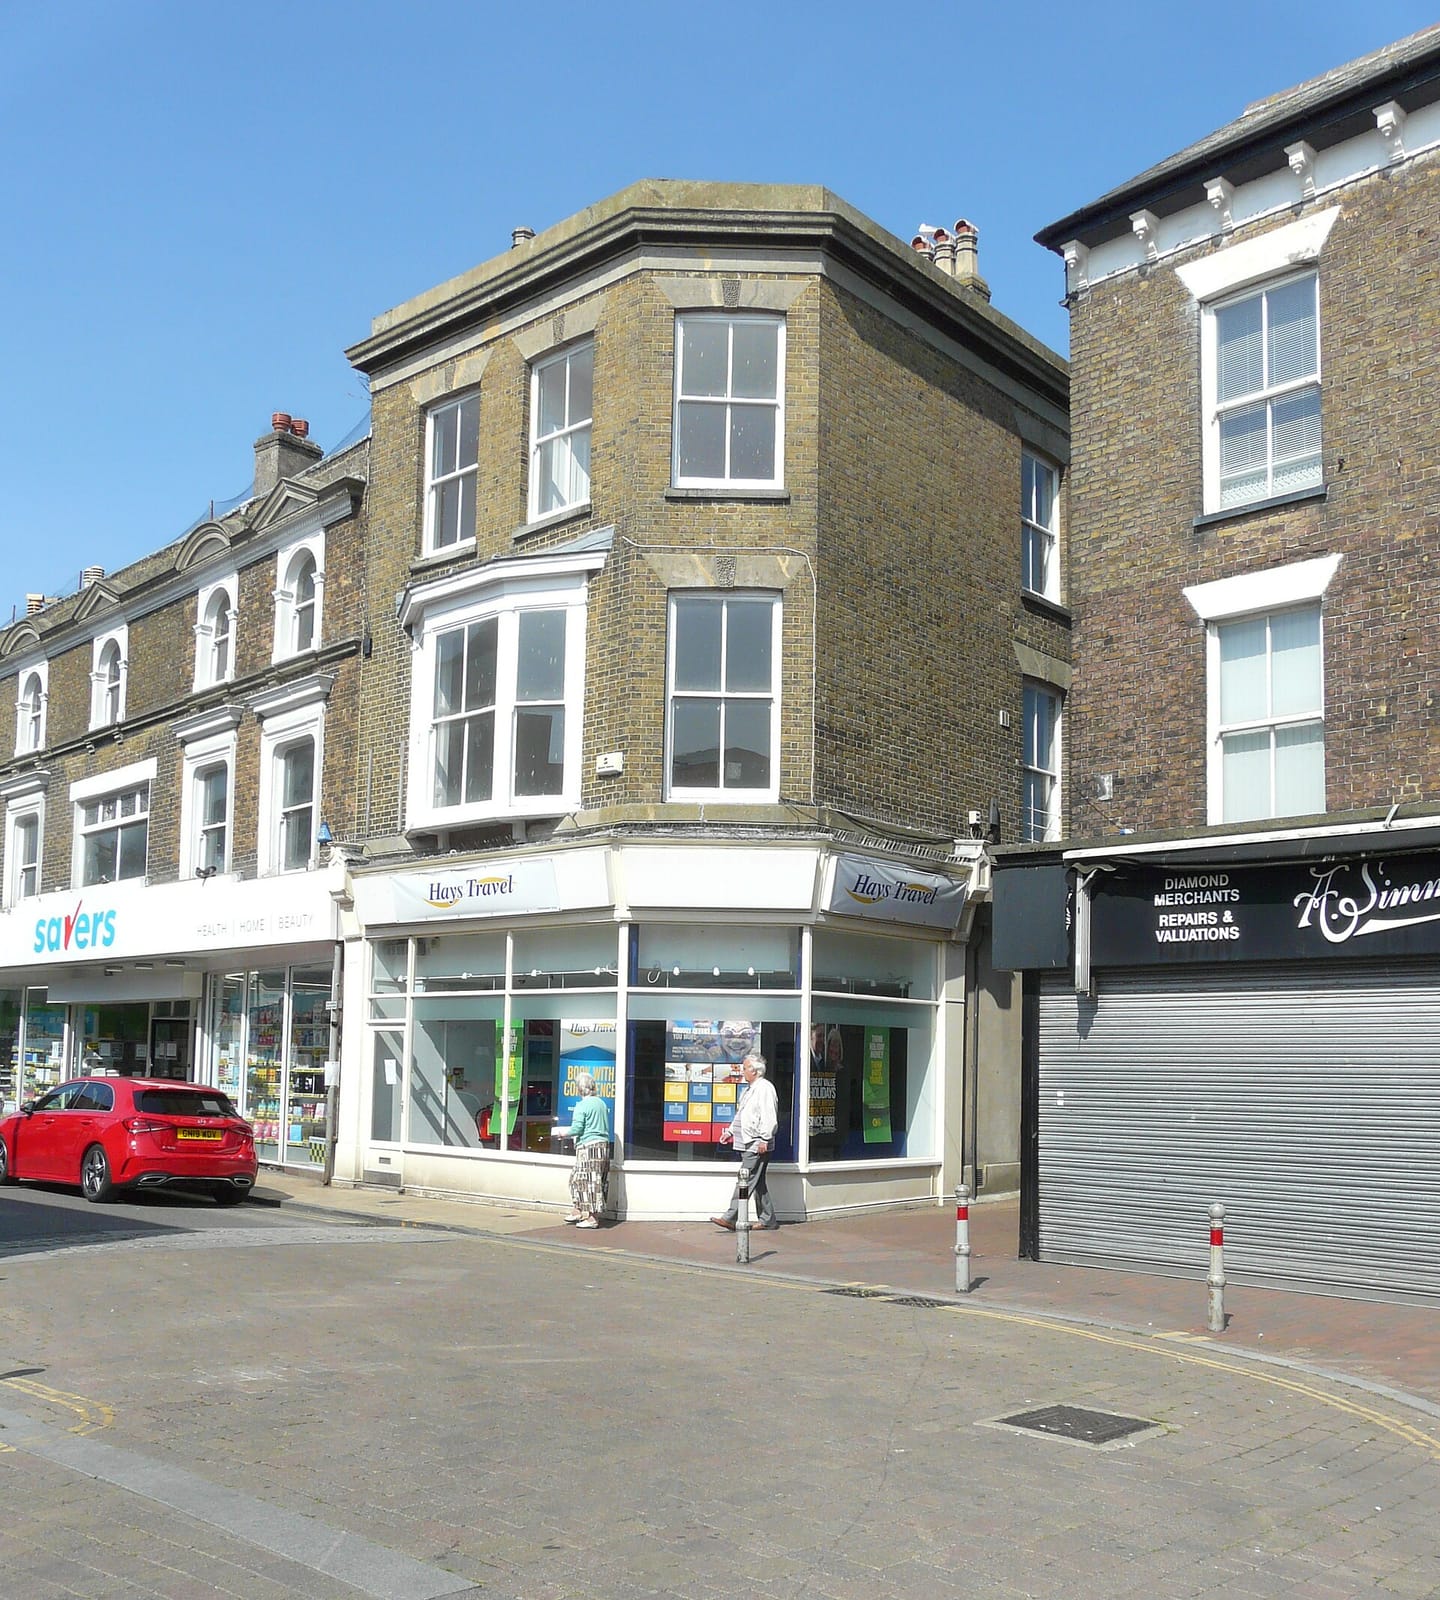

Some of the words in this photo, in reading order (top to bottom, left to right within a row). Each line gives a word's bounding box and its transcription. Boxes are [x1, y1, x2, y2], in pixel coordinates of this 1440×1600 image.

[429, 881, 463, 904] Hays
[466, 874, 514, 898] Travel
[852, 874, 892, 901] Hays
[893, 881, 939, 905] Travel
[1164, 874, 1229, 890] DIAMOND
[1154, 889, 1240, 906] MERCHANTS
[33, 899, 117, 953] savers
[196, 922, 229, 937] HEALTH
[239, 918, 265, 933] HOME
[279, 912, 314, 929] BEAUTY
[1159, 912, 1218, 927] REPAIRS
[1222, 909, 1234, 923] &
[1155, 926, 1240, 943] VALUATIONS
[570, 1023, 591, 1035] Hays
[592, 1022, 617, 1034] Travel
[563, 1081, 616, 1098] COENCE
